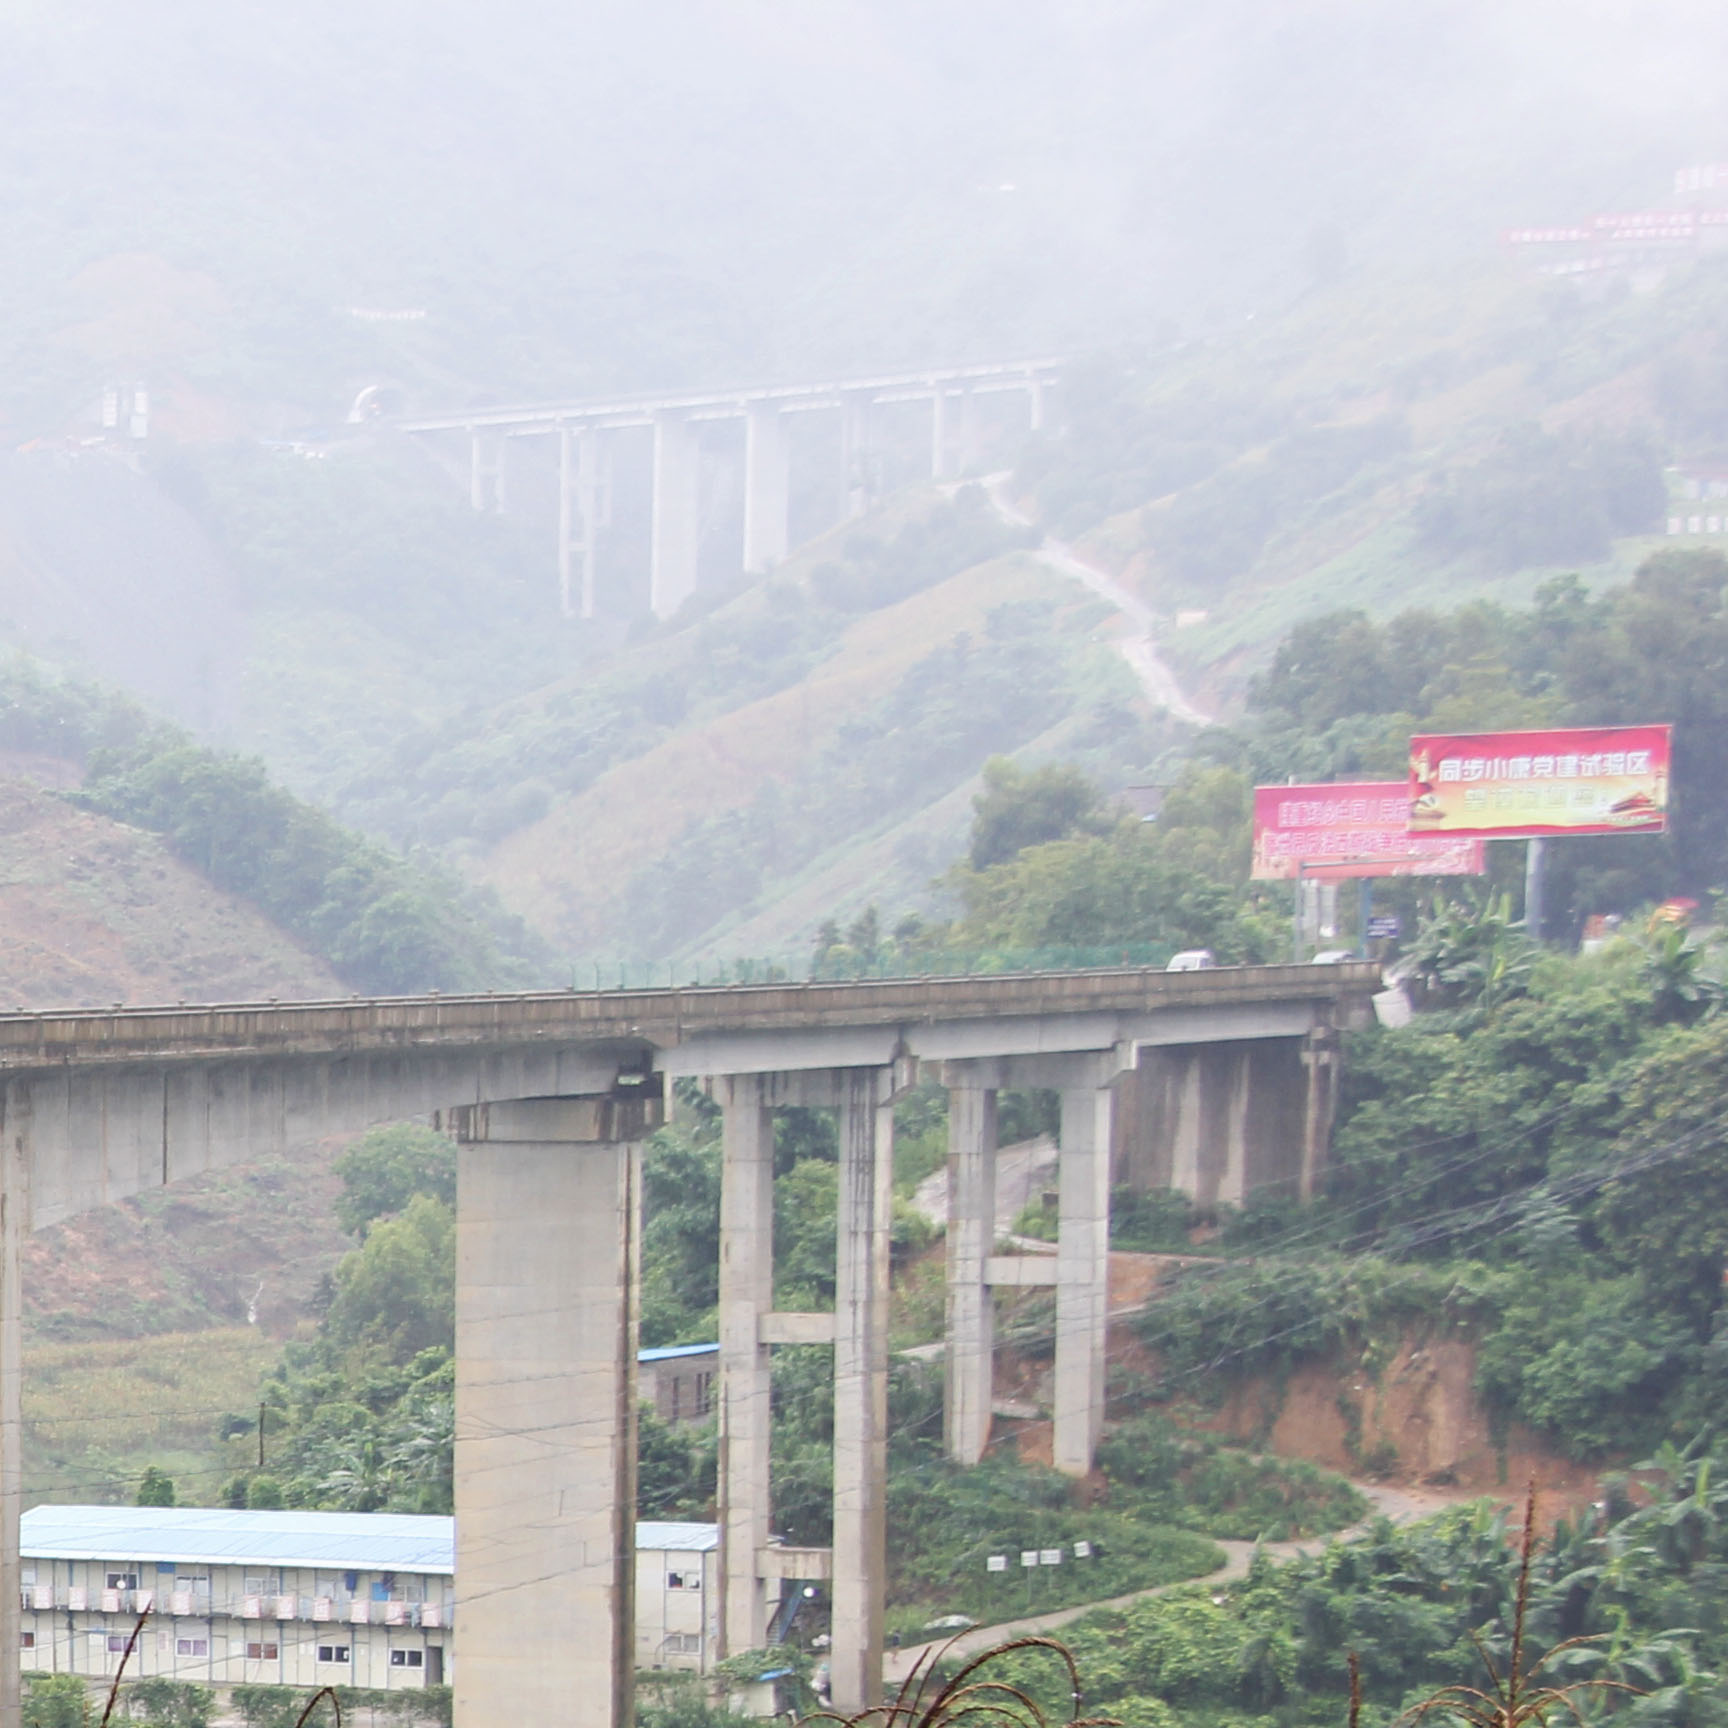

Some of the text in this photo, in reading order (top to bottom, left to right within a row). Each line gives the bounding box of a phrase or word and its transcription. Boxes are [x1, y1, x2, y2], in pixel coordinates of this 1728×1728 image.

[1439, 750, 1651, 782] 同步小康党建试验区
